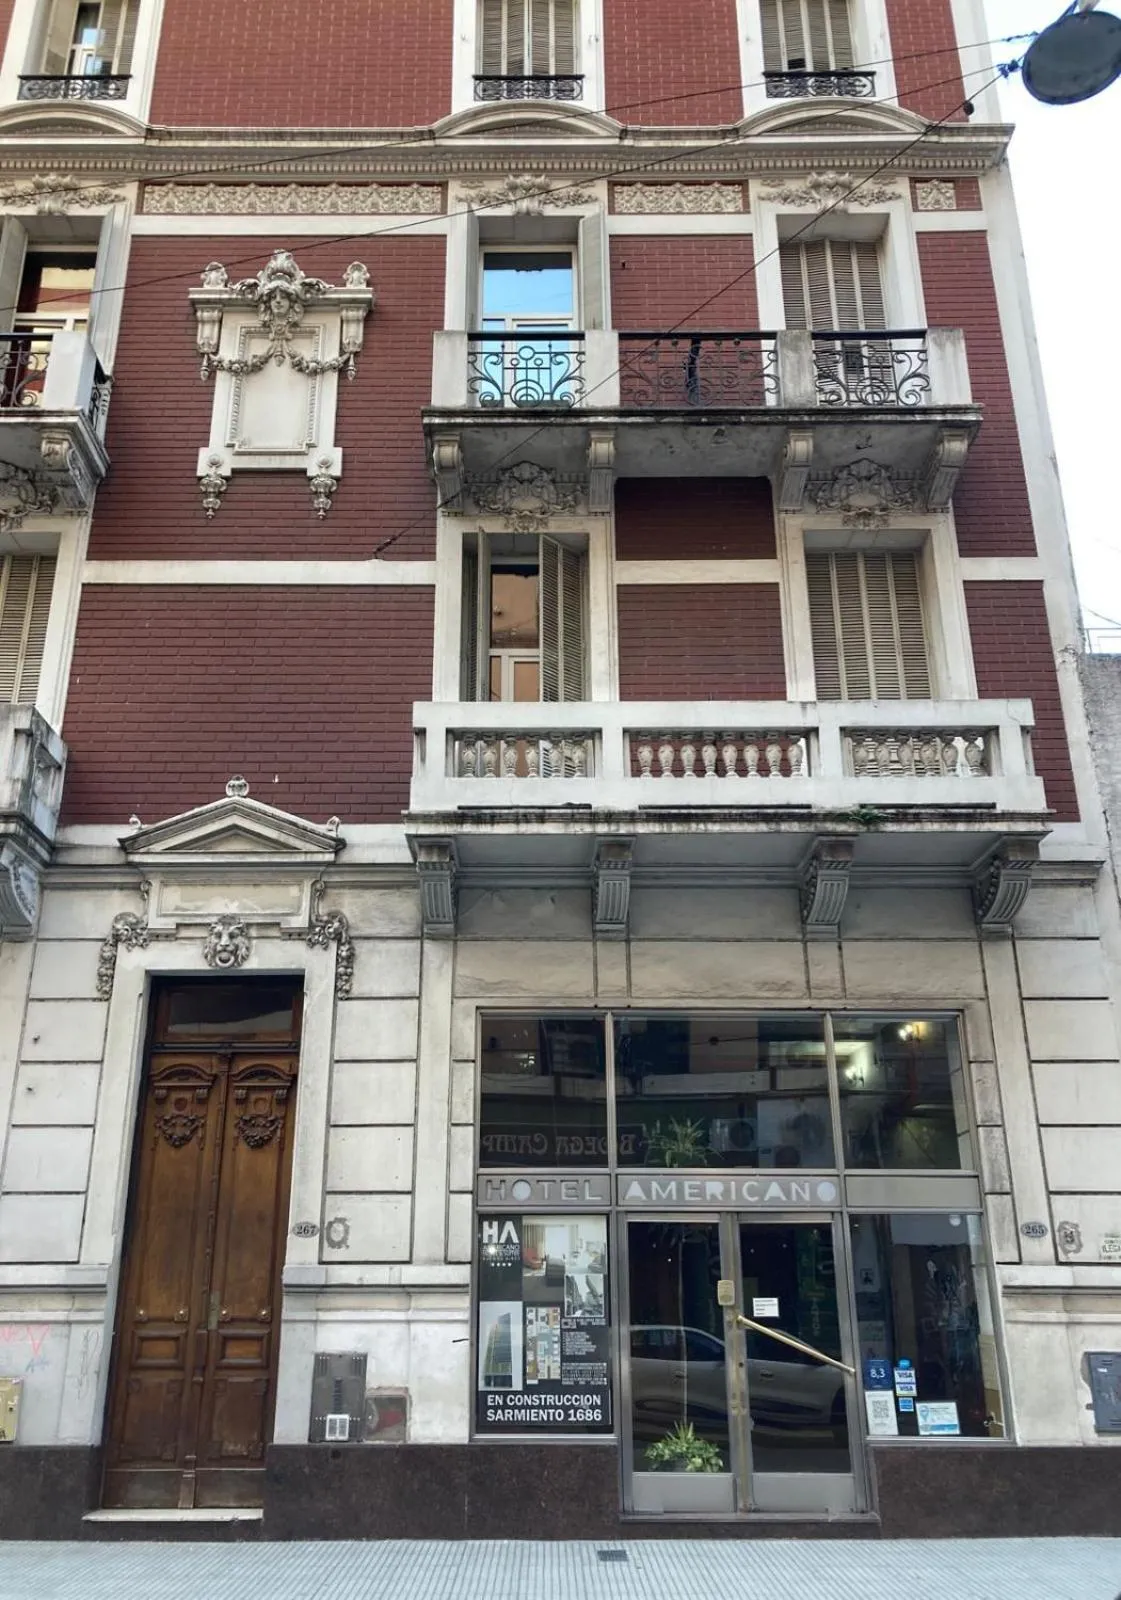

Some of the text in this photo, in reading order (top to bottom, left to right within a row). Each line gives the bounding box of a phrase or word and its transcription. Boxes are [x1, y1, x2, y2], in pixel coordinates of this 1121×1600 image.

[486, 1179, 836, 1202] HOTEL AMERICANO
[296, 1224, 316, 1235] 267
[1025, 1224, 1045, 1234] 265
[870, 1368, 886, 1379] 8,3
[487, 1394, 601, 1406] EN CONSTRUCCION
[486, 1408, 602, 1421] SARMIENTO 1686
